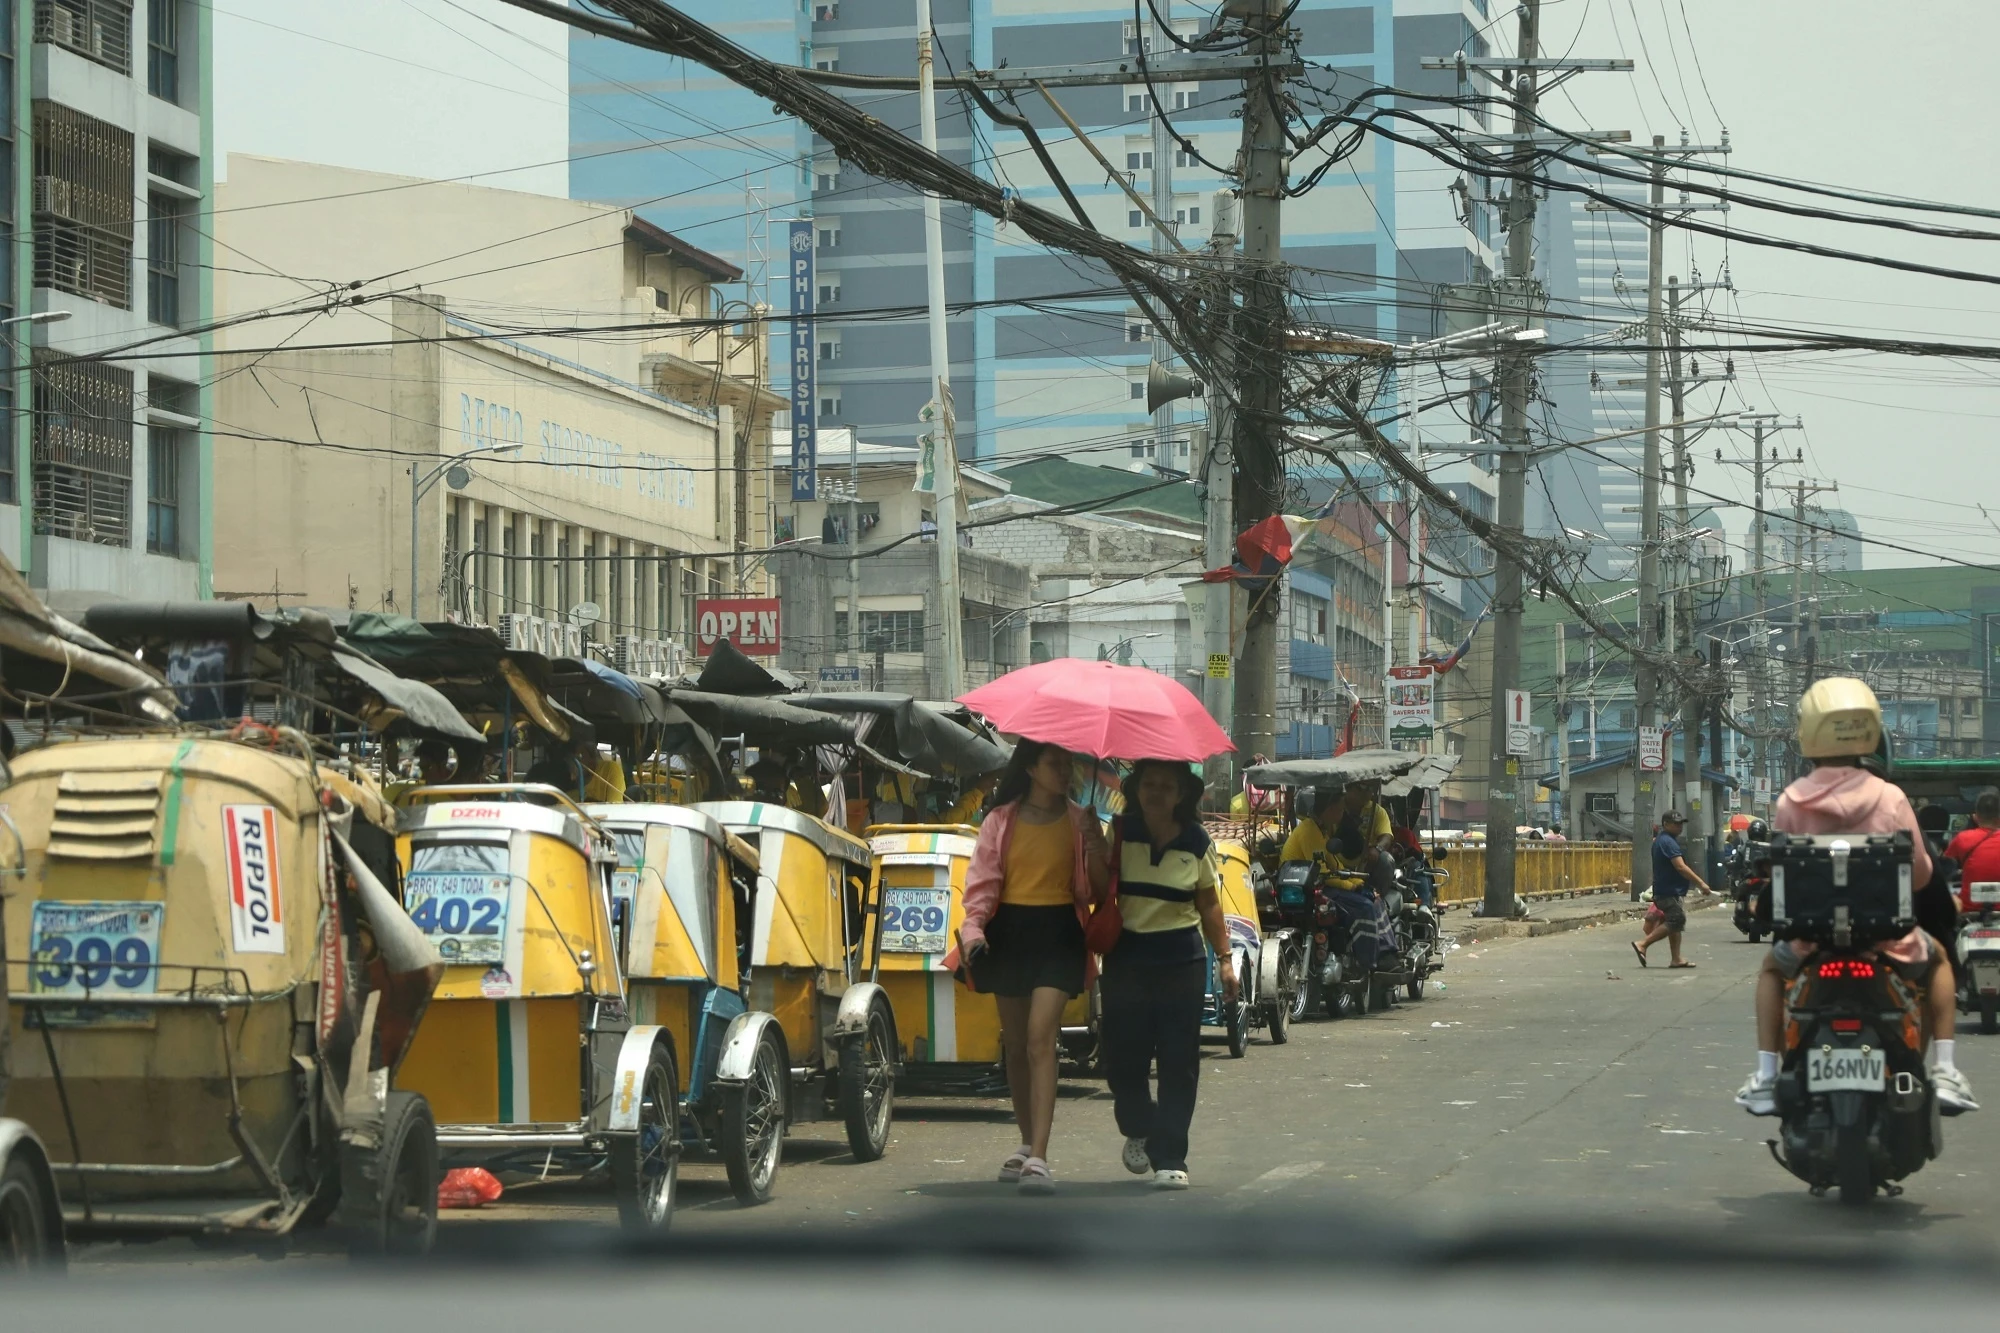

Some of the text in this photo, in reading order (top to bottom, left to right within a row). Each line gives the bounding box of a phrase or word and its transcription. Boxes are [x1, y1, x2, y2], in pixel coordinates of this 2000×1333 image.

[796, 259, 810, 491] PHILTRUST BANK
[540, 420, 622, 489] SHOPPING
[637, 452, 695, 509] CENTER
[700, 610, 777, 645] OPEN
[451, 808, 501, 818] DZRH
[243, 818, 270, 938] REPSOL
[413, 876, 484, 895] BRGY. 649 TODA
[902, 891, 913, 904] 649
[915, 892, 932, 904] TODA
[411, 898, 501, 934] 402
[882, 906, 944, 932] 269
[36, 937, 150, 988] 399
[325, 946, 336, 986] VICE
[1811, 1059, 1881, 1081] 166NVV
